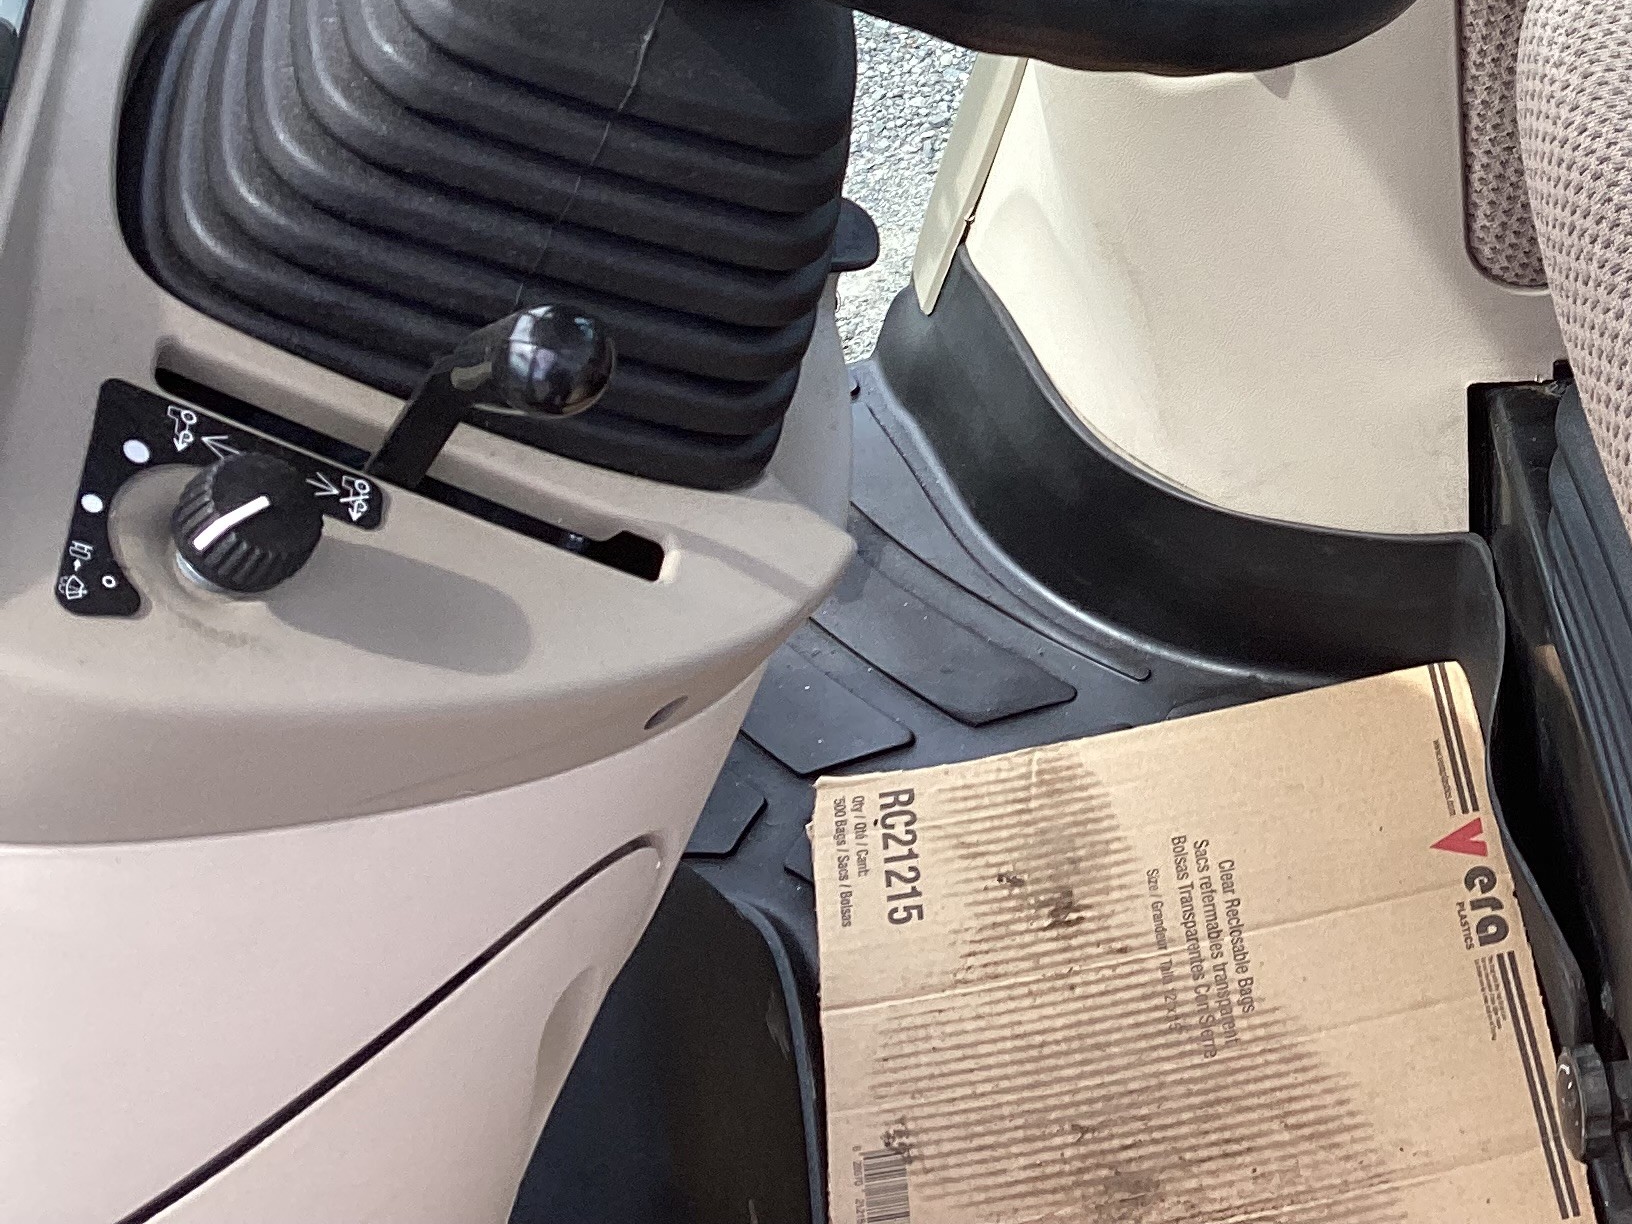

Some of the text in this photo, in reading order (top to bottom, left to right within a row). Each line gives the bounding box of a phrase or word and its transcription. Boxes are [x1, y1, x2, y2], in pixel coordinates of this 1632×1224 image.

[834, 797, 846, 818] 500
[850, 796, 865, 813] Qty
[833, 819, 847, 845] Bags
[854, 822, 868, 840] Qté
[838, 855, 850, 881] Sacs
[857, 849, 869, 877] Cant:
[879, 788, 924, 925] RC21215
[1171, 835, 1191, 881] Bolsas
[1146, 868, 1160, 892] Size
[840, 891, 853, 927] Bolsas
[1151, 901, 1169, 951] Grandeur
[1176, 882, 1207, 981] Transparentes
[1218, 860, 1256, 1014] Clear Reclosable Bags
[1456, 902, 1475, 950] PLASTICS
[1192, 839, 1240, 1046] Sacs refermables transparent
[1193, 984, 1212, 1011] Con
